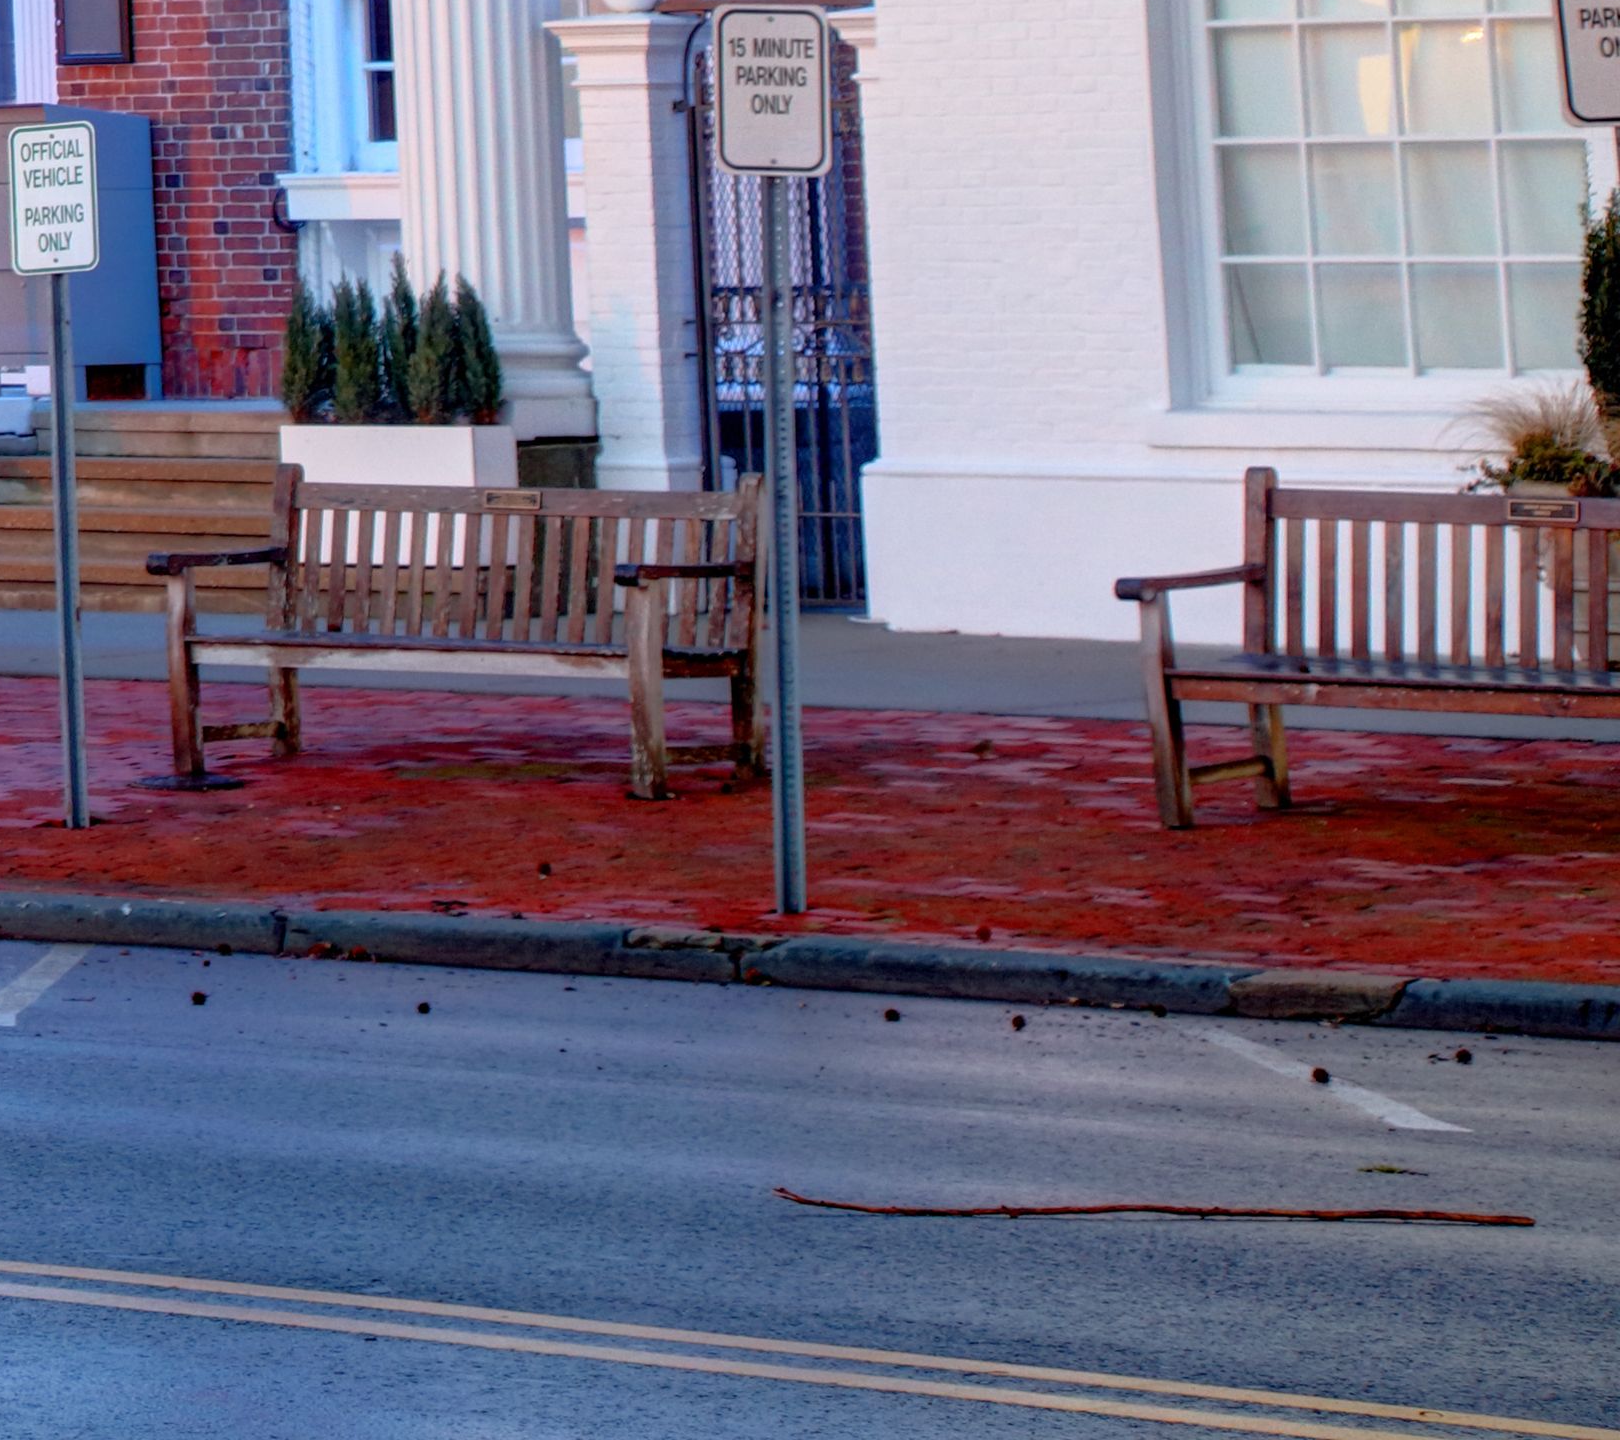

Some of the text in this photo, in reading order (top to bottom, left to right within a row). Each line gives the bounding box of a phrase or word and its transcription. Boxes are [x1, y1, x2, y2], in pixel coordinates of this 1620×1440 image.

[1580, 7, 1620, 29] PAR
[728, 38, 815, 59] 15 MINUTE
[736, 65, 807, 87] PARKING
[751, 93, 793, 115] ONLY
[20, 139, 84, 162] OFFICIAL
[23, 165, 84, 189] VEHICLE
[24, 203, 84, 227] PARKING
[38, 231, 72, 253] ONLY
